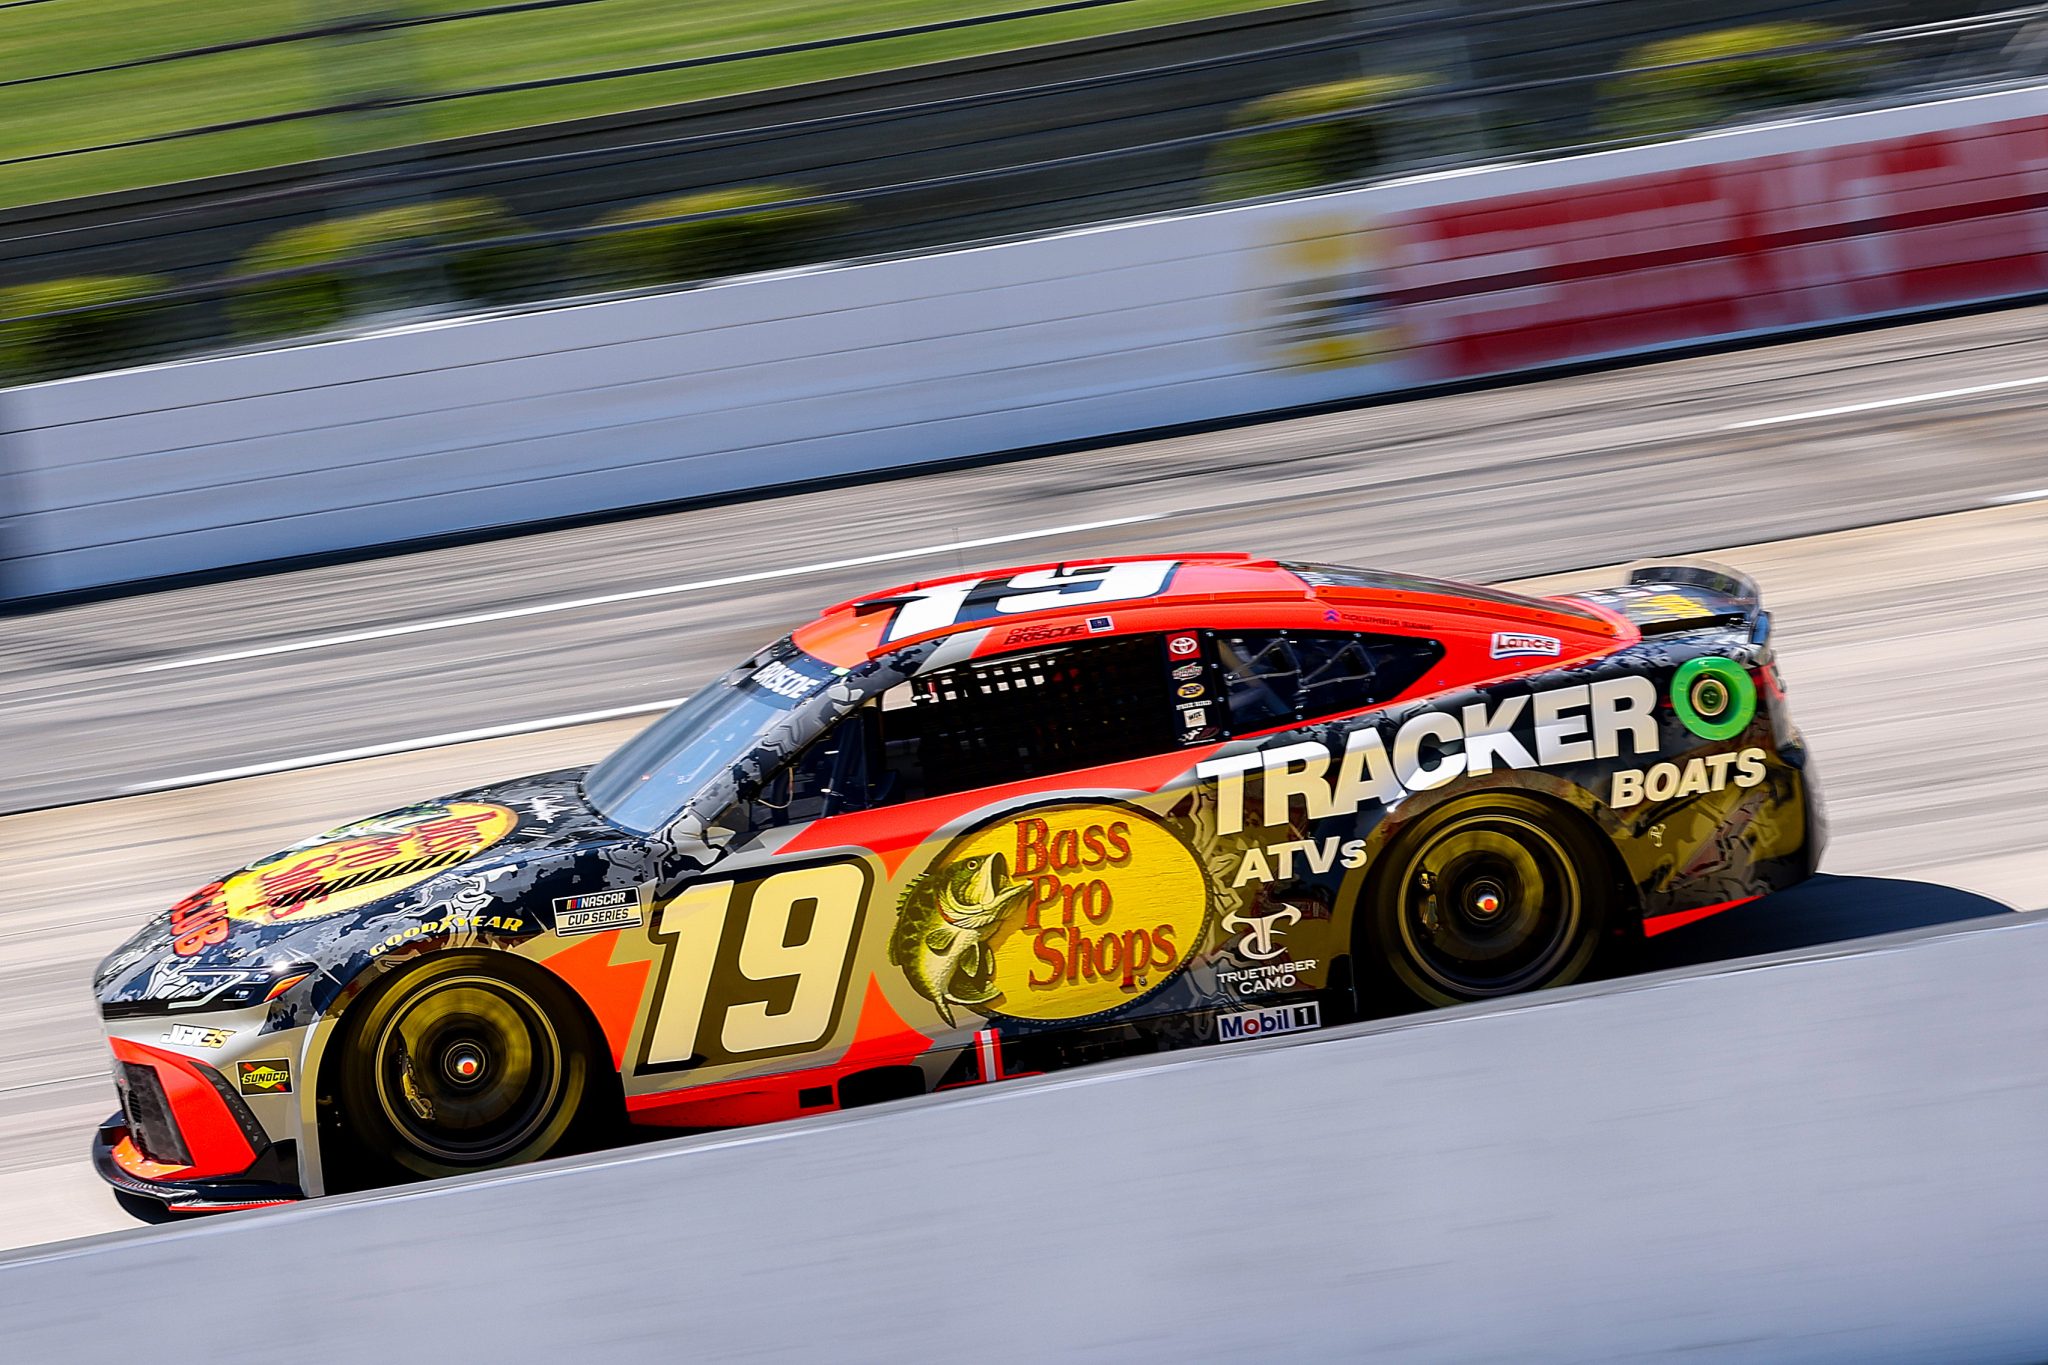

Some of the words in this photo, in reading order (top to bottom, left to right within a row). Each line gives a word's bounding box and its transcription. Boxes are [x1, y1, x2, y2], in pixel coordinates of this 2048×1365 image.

[1003, 624, 1087, 645] BRISCOE
[1497, 635, 1556, 650] Lance
[751, 661, 820, 698] BRISCOE
[1196, 675, 1660, 836] TRACKER
[1611, 747, 1767, 809] BOATS
[1011, 817, 1131, 876] Bass
[1232, 836, 1368, 888] ATVs
[170, 881, 229, 957] CLUB
[568, 912, 590, 926] CUP
[591, 908, 629, 923] SERIES
[581, 892, 626, 908] NASCAR
[1021, 874, 1112, 930] Pro
[369, 915, 523, 956] GOODYEAR
[648, 863, 865, 1065] 19
[1029, 924, 1177, 990] Shops
[1216, 959, 1317, 983] TRUETIMBER
[1239, 974, 1296, 994] CAMO
[1221, 1009, 1290, 1038] Mobil
[243, 1071, 287, 1084] SUNOCO
